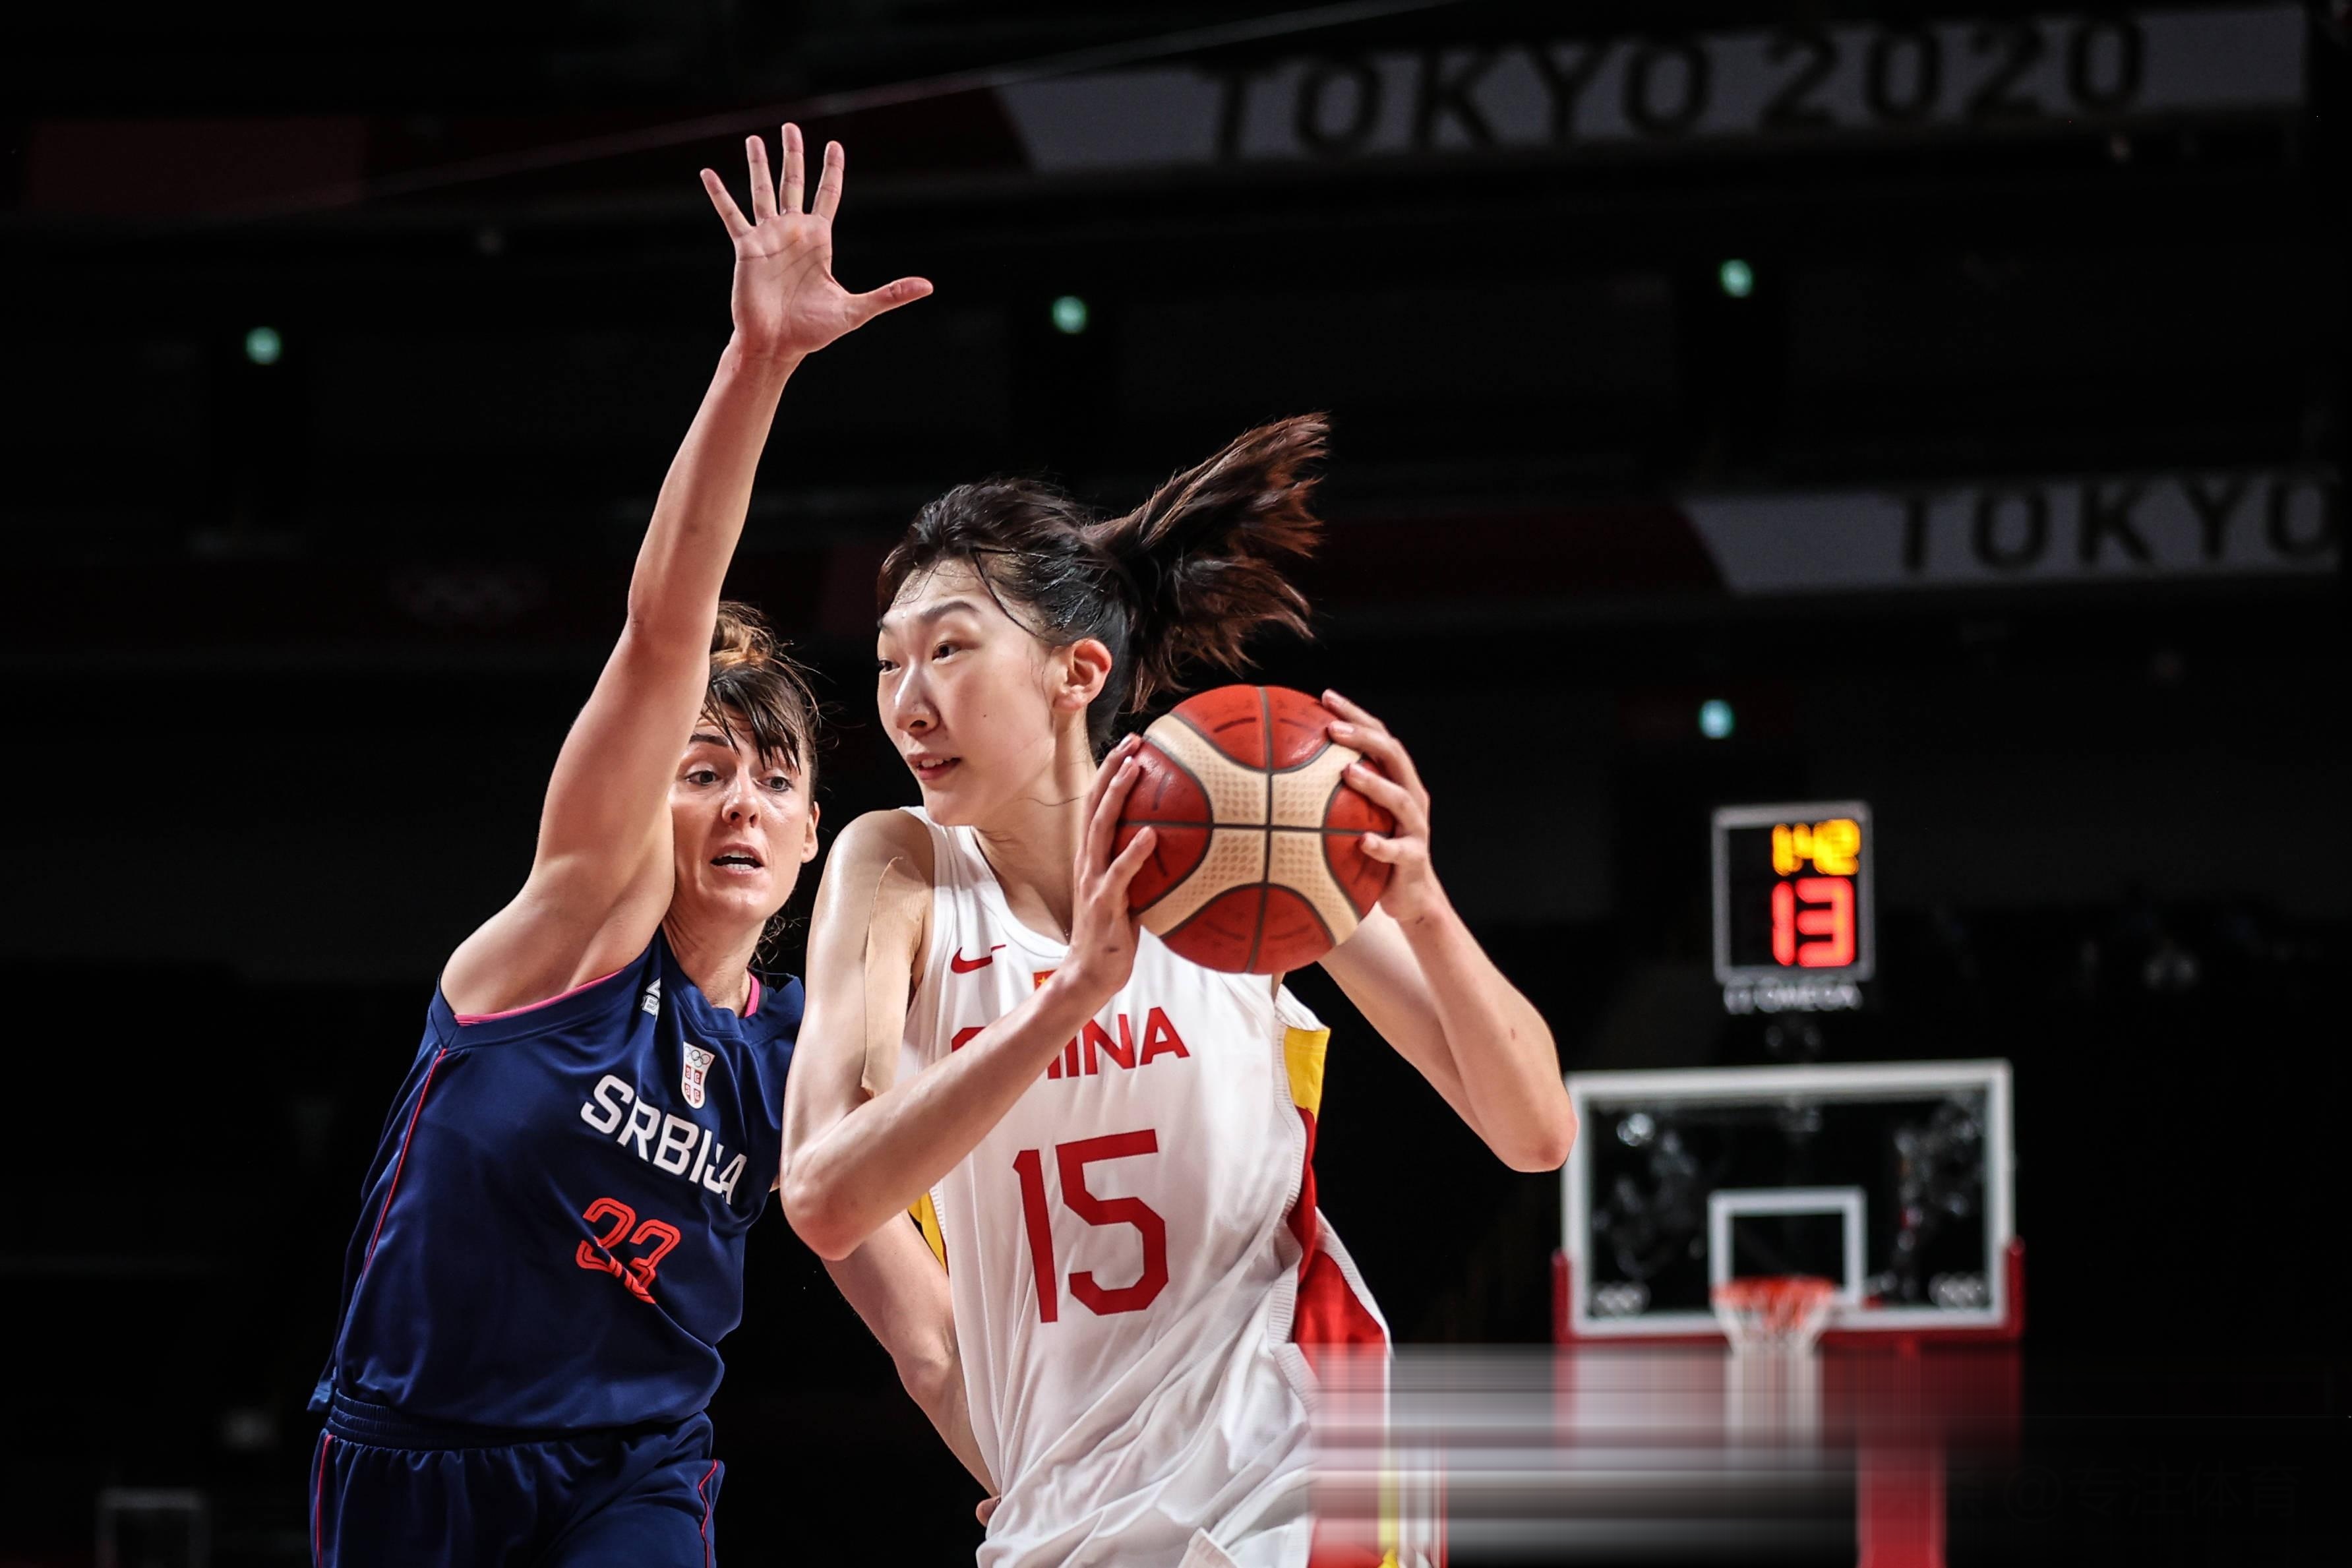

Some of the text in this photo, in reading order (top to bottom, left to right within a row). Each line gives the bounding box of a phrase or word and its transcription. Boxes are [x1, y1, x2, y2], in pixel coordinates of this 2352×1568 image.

[1199, 17, 2143, 164] TOKYO 2020
[1886, 468, 2345, 571] TOKYO
[1770, 876, 1857, 967] 13
[951, 1007, 1190, 1080] INA
[580, 1074, 747, 1206] SRBIJA
[576, 1197, 681, 1304] 33
[1013, 1129, 1168, 1323] 15
